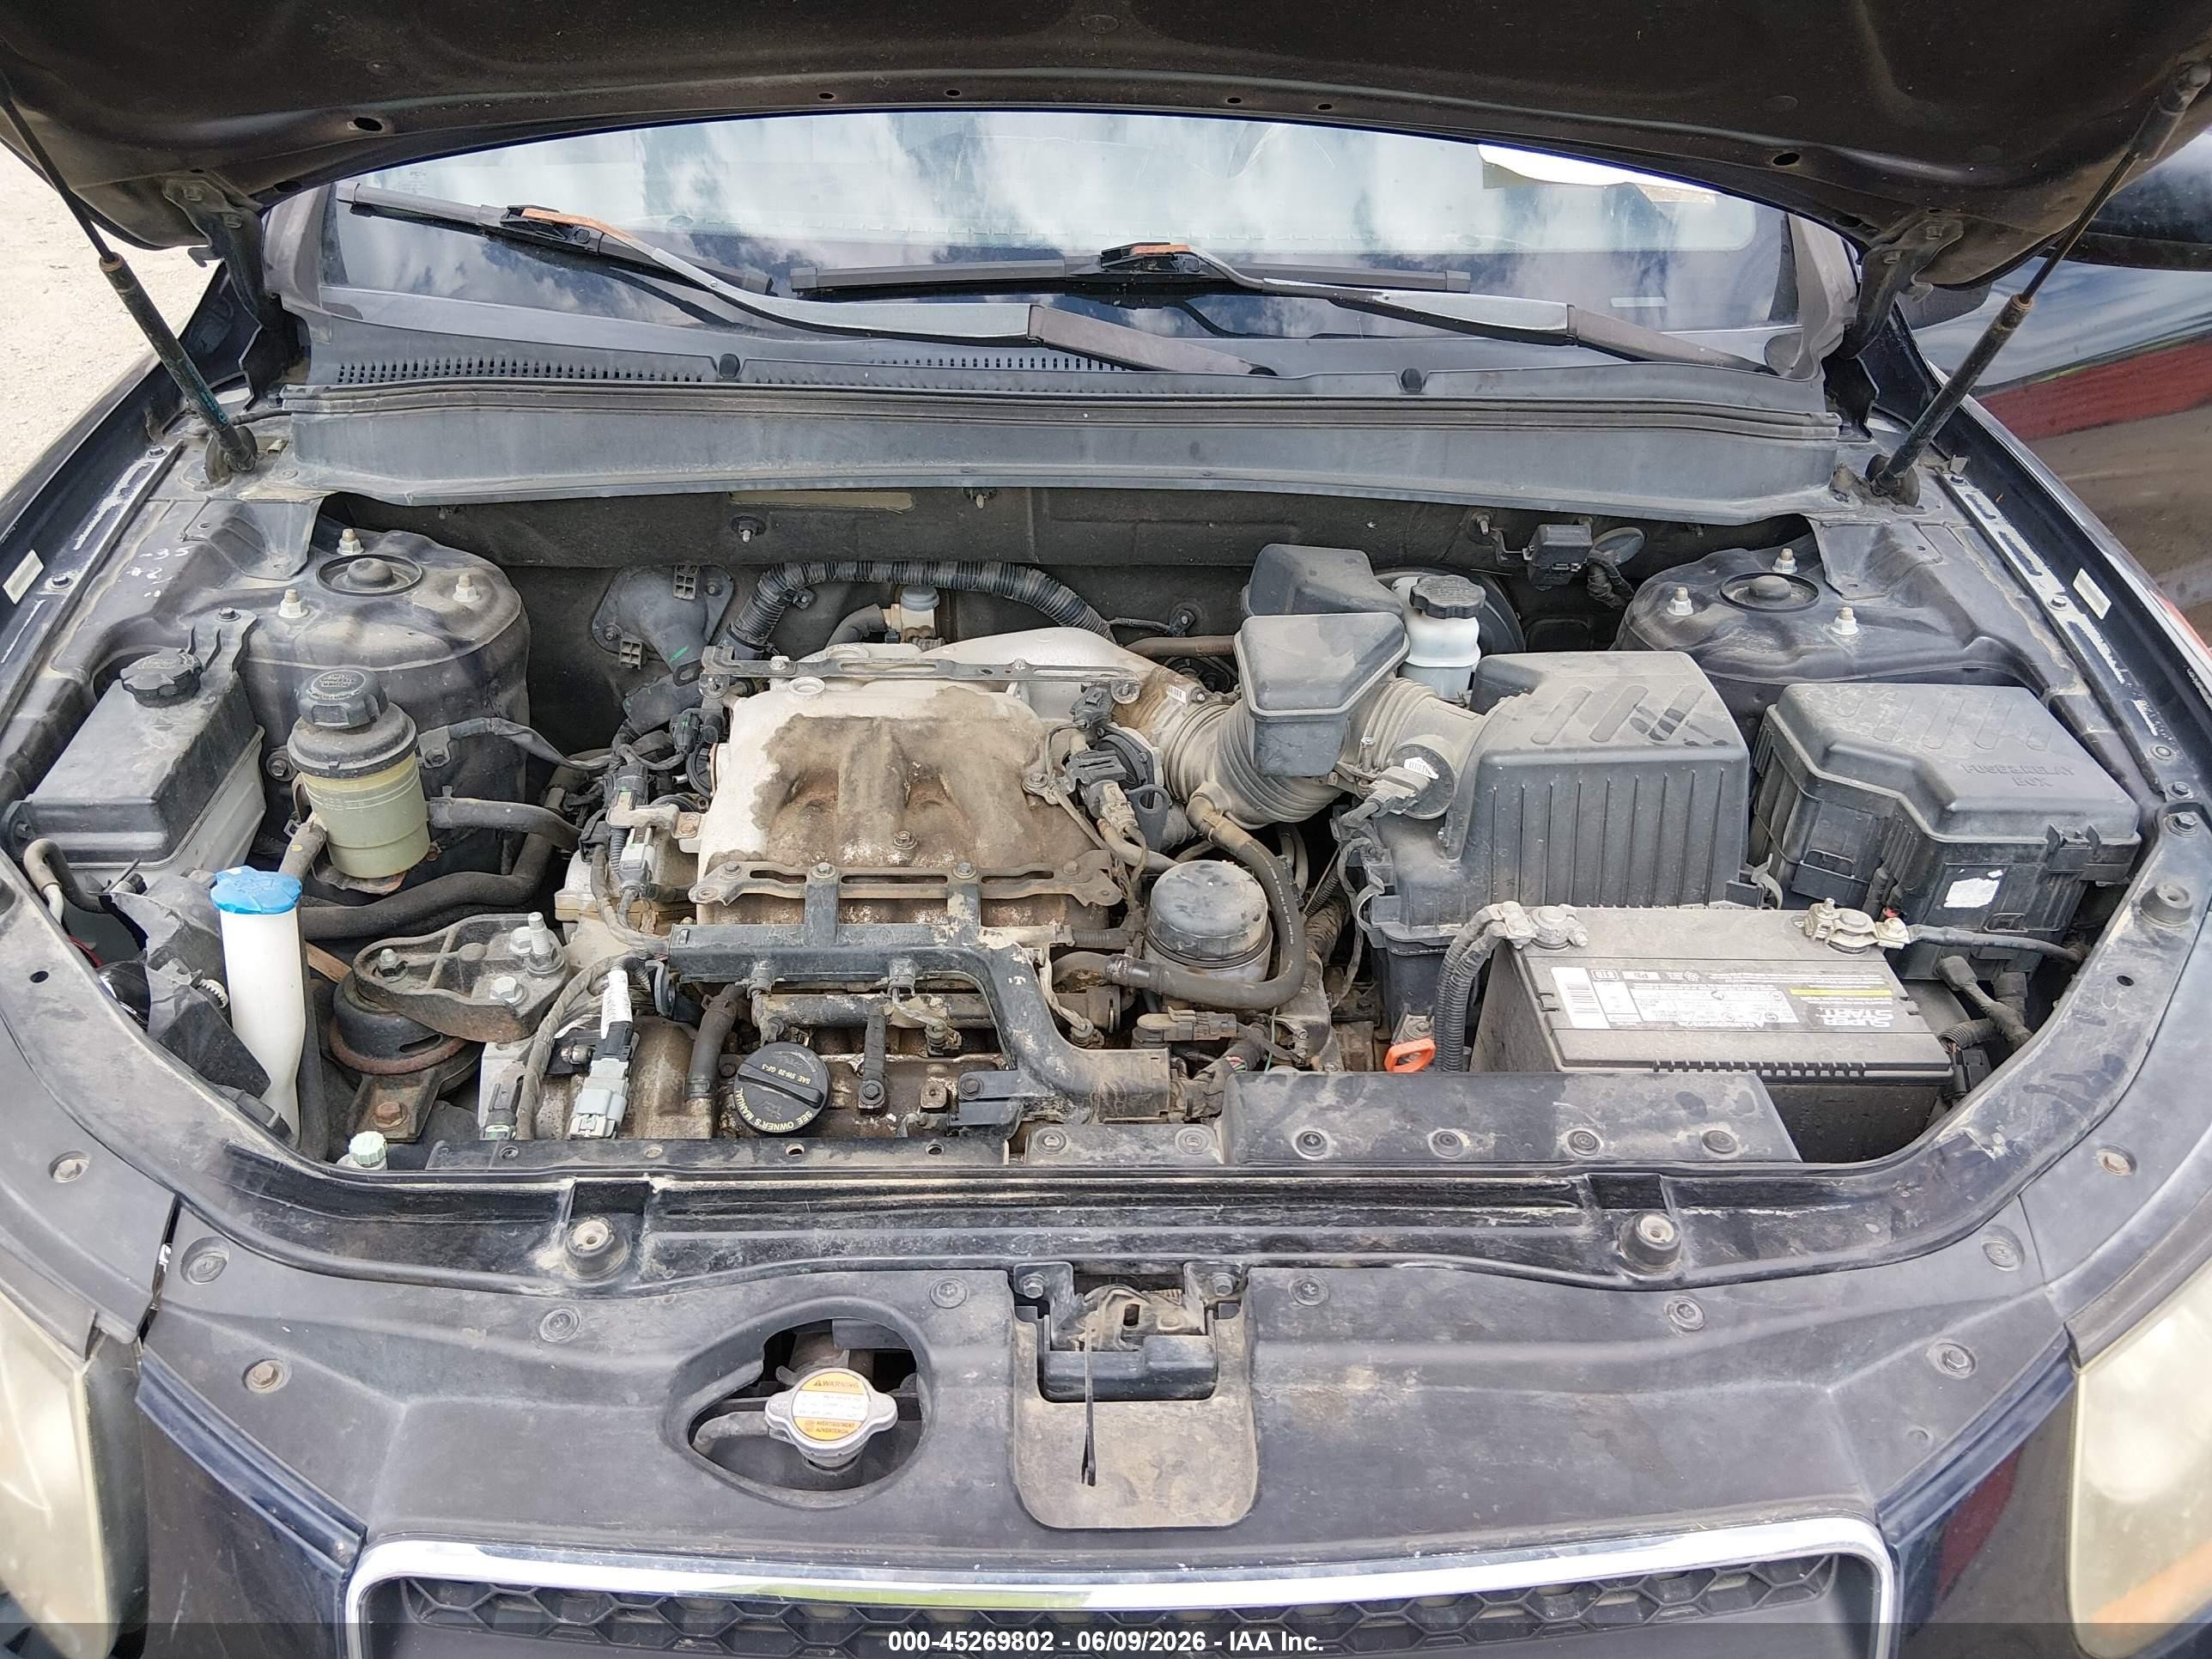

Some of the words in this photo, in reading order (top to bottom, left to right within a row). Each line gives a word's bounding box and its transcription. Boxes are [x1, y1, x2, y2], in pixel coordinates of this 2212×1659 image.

[1820, 1009, 1894, 1019] START
[1823, 1018, 1891, 1028] SUPER
[797, 1075, 811, 1085] SAE
[735, 1087, 755, 1121] MANUAL
[796, 1110, 813, 1126] SEE
[754, 1117, 794, 1131] OWNER'S
[823, 1380, 860, 1389] WARNING
